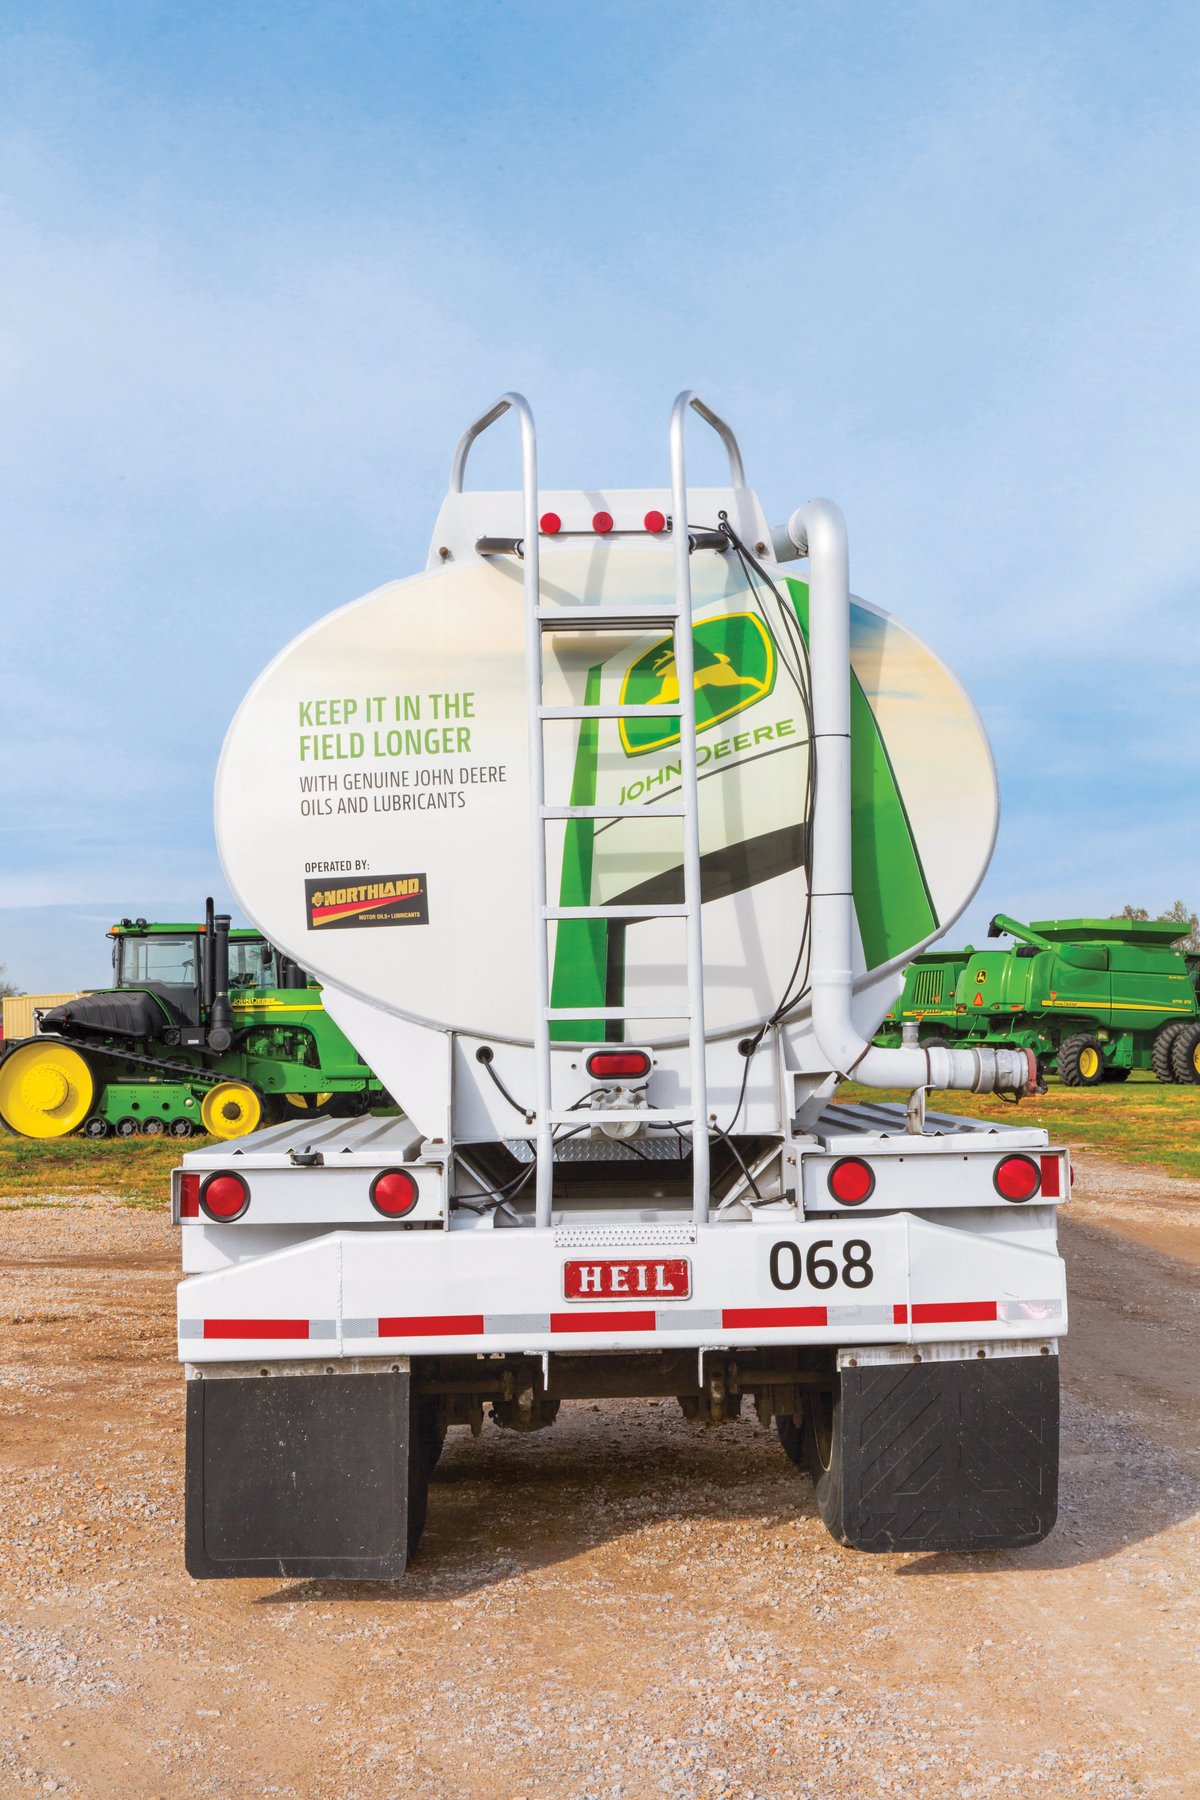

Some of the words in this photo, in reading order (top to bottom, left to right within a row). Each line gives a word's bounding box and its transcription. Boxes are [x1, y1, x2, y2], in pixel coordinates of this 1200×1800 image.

[299, 698, 358, 727] KEEP
[366, 696, 387, 723] IT
[395, 695, 420, 721] IN
[428, 692, 475, 719] THE
[299, 732, 365, 761] FIELD
[373, 726, 472, 757] LONGER
[300, 774, 338, 793] WITH
[343, 770, 410, 790] GENUINE
[414, 768, 454, 787] JOHN
[459, 765, 507, 784] DEERE
[619, 760, 682, 806] JOHN
[300, 798, 333, 816] OILS
[337, 796, 368, 814] AND
[373, 791, 466, 812] LUBRICANTS
[305, 860, 352, 873] OPERATED
[355, 859, 370, 870] BY:
[324, 877, 420, 906] NORTHLAND
[391, 911, 421, 919] LUBRICANTS
[579, 1265, 674, 1292] HEIL
[769, 1239, 874, 1290] 068
